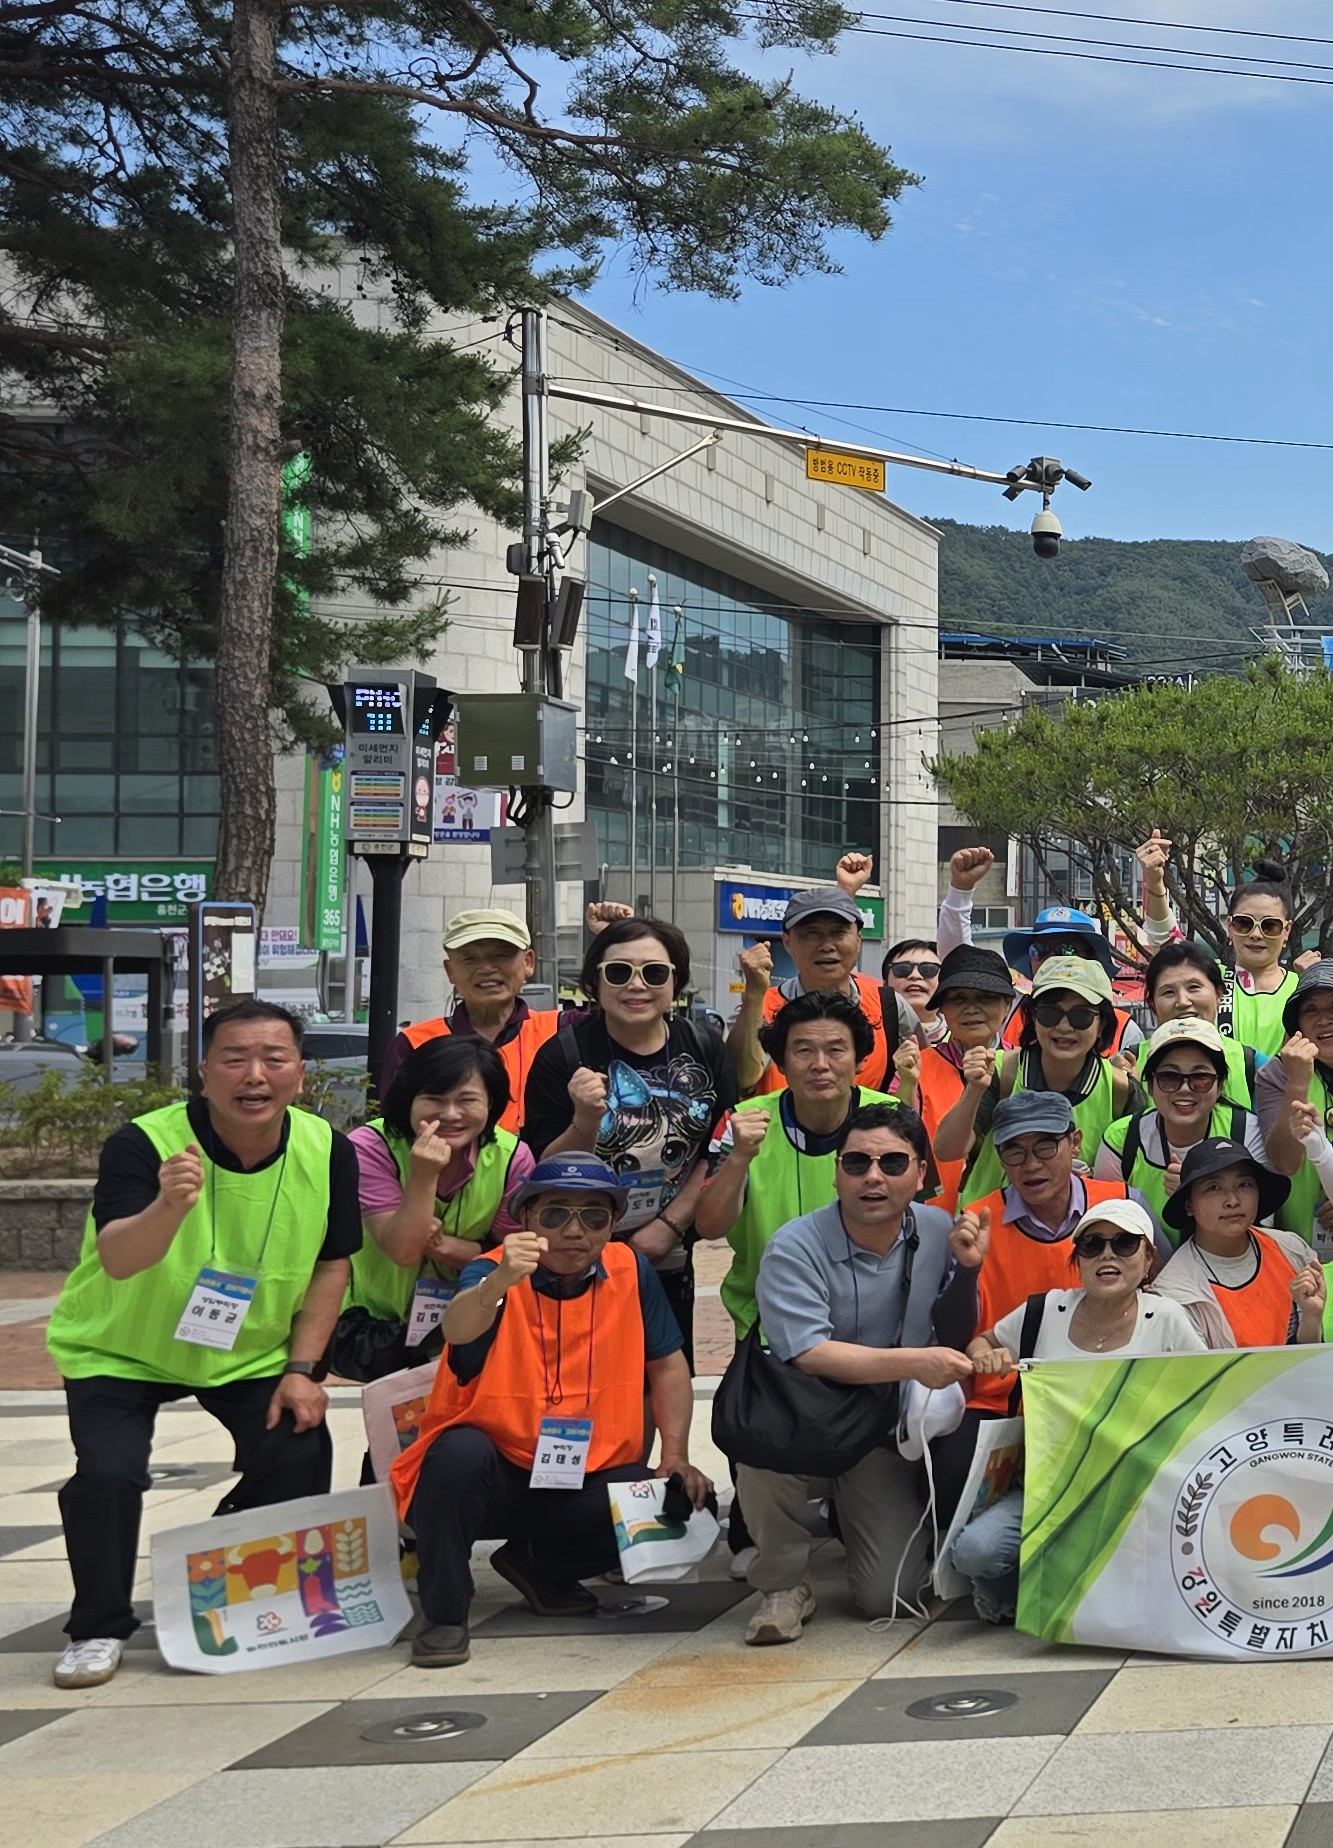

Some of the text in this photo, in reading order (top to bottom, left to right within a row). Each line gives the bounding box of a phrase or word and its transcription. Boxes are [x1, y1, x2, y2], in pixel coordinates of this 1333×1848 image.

[837, 462, 856, 476] CCTV
[358, 743, 398, 754] 미세먼지
[362, 754, 393, 765] 알리미
[323, 909, 342, 927] 365
[1249, 1451, 1305, 1468] GANGWON
[1252, 1595, 1326, 1610] since 2018
